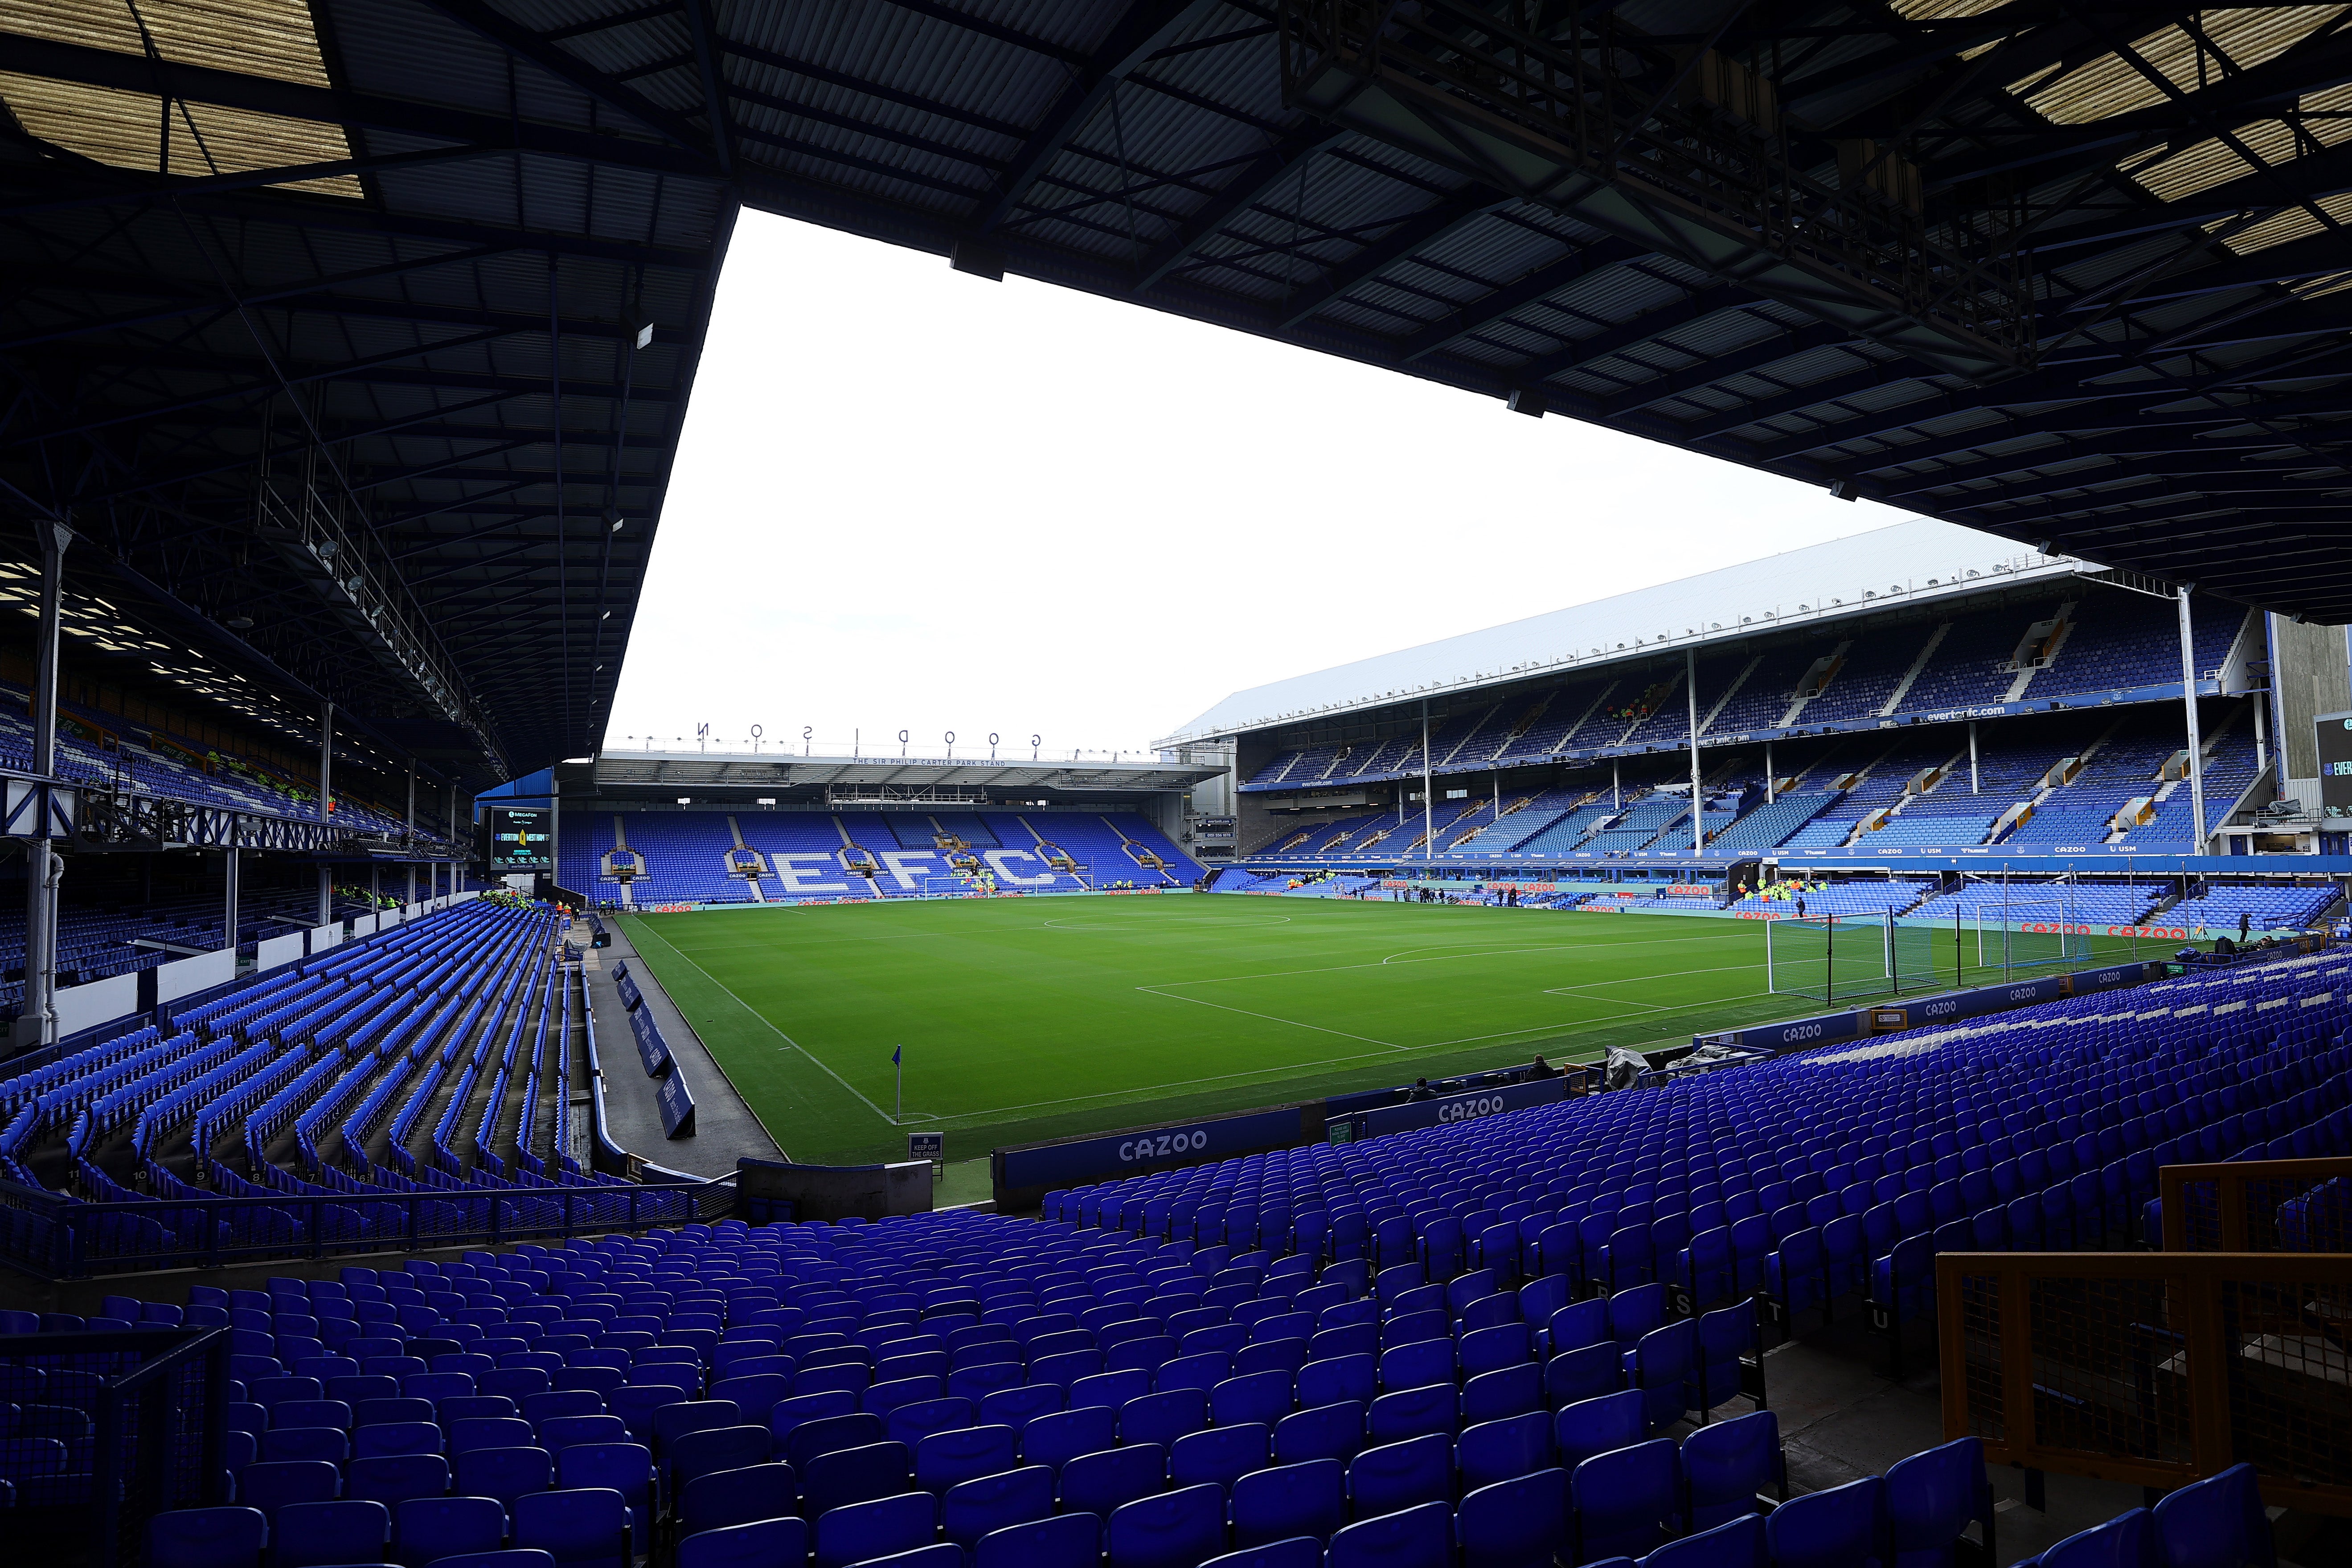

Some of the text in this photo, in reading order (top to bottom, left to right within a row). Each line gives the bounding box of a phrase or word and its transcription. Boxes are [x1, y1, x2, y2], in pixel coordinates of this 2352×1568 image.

[161, 745, 177, 755] EXIT
[501, 833, 519, 841] EVERTON
[1523, 883, 1555, 892] CAZOO
[1667, 885, 1709, 895] CAZOO
[1735, 911, 1781, 920] CAZOO
[2021, 923, 2091, 935] CAZOO
[2108, 926, 2187, 940] CAZOO
[2267, 950, 2282, 961] CAZOO
[2098, 971, 2120, 984] CAZOO
[2010, 986, 2036, 1001] CAZOO
[1926, 1000, 1956, 1016] CAZOO
[1783, 1024, 1821, 1042] CAZOO
[649, 1048, 662, 1067] CAZOO
[663, 1078, 676, 1103] CAZOO
[1438, 1095, 1504, 1123] CAZOO
[1119, 1130, 1208, 1162] CAZOO
[68, 1170, 80, 1178] 11
[133, 1171, 148, 1180] 10
[197, 1172, 205, 1180] 9
[252, 1173, 260, 1181] 8
[308, 1174, 315, 1182] 7
[1677, 1294, 1690, 1314] S
[1769, 1302, 1781, 1321] T
[1874, 1309, 1888, 1329] U
